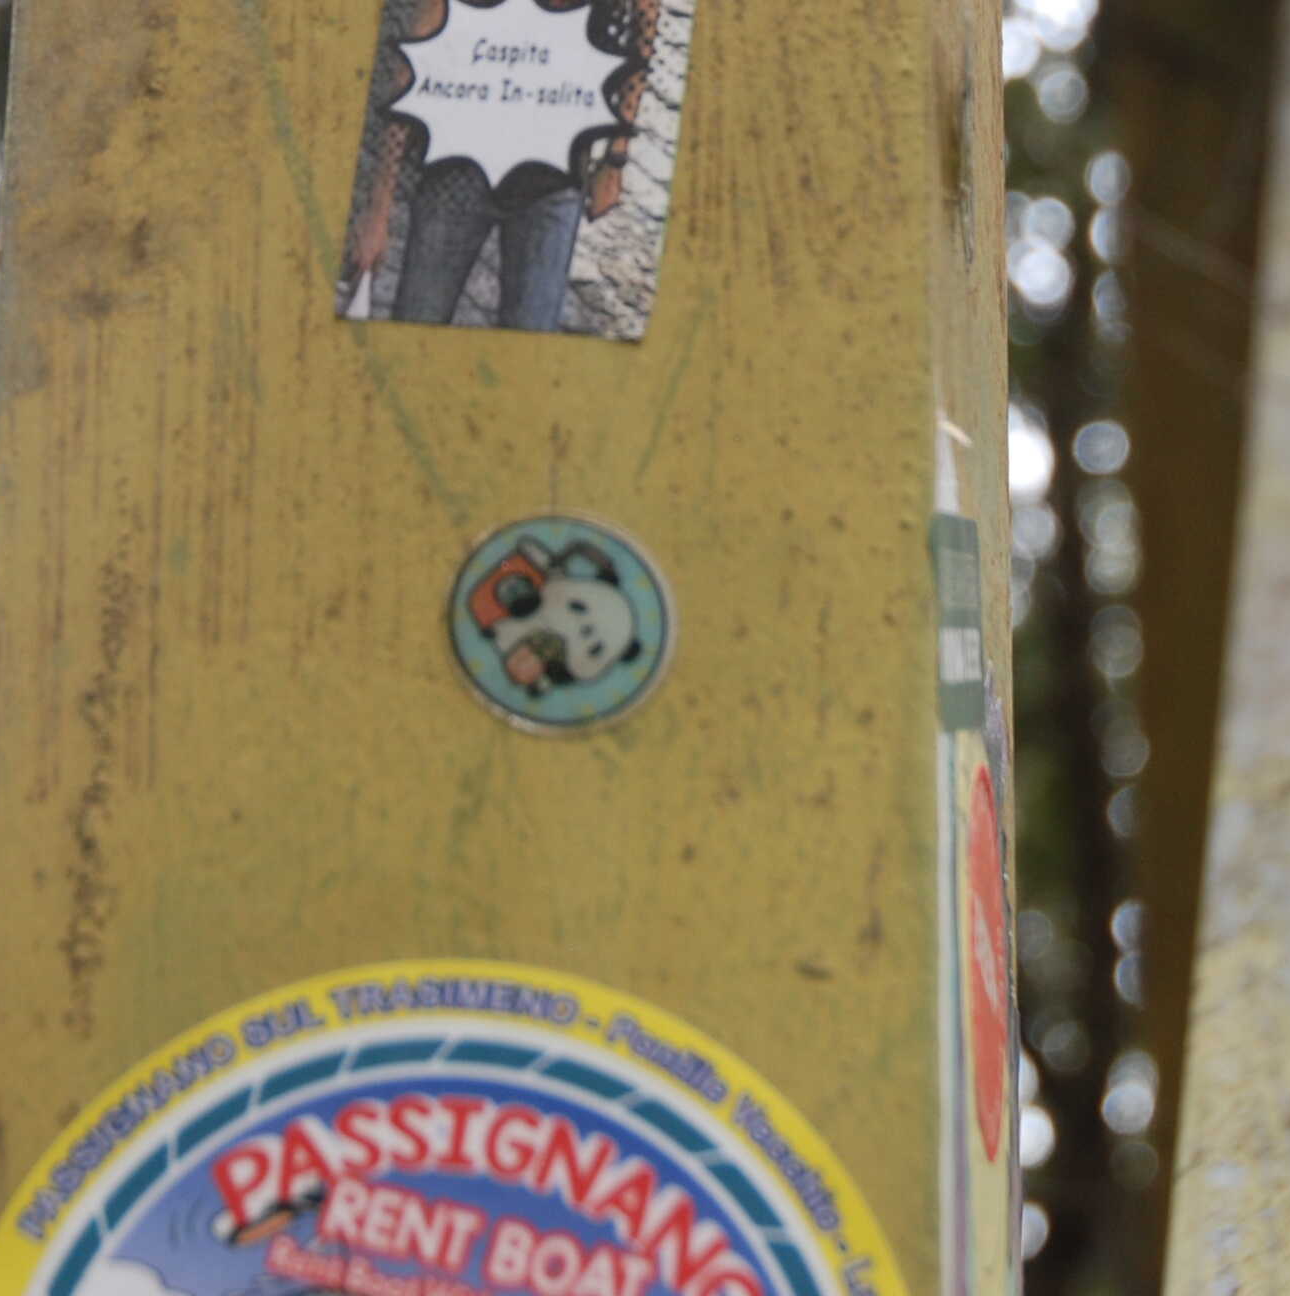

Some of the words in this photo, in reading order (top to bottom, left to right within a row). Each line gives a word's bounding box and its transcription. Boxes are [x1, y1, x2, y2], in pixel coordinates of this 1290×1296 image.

[472, 37, 550, 67] Caspita
[418, 76, 489, 102] Ancora
[500, 78, 595, 107] In-salita
[17, 1033, 237, 1242] PASSIGNANO
[327, 975, 580, 1026] TRASIMENO
[322, 1178, 483, 1273] RENT
[484, 1216, 656, 1296] BOAT
